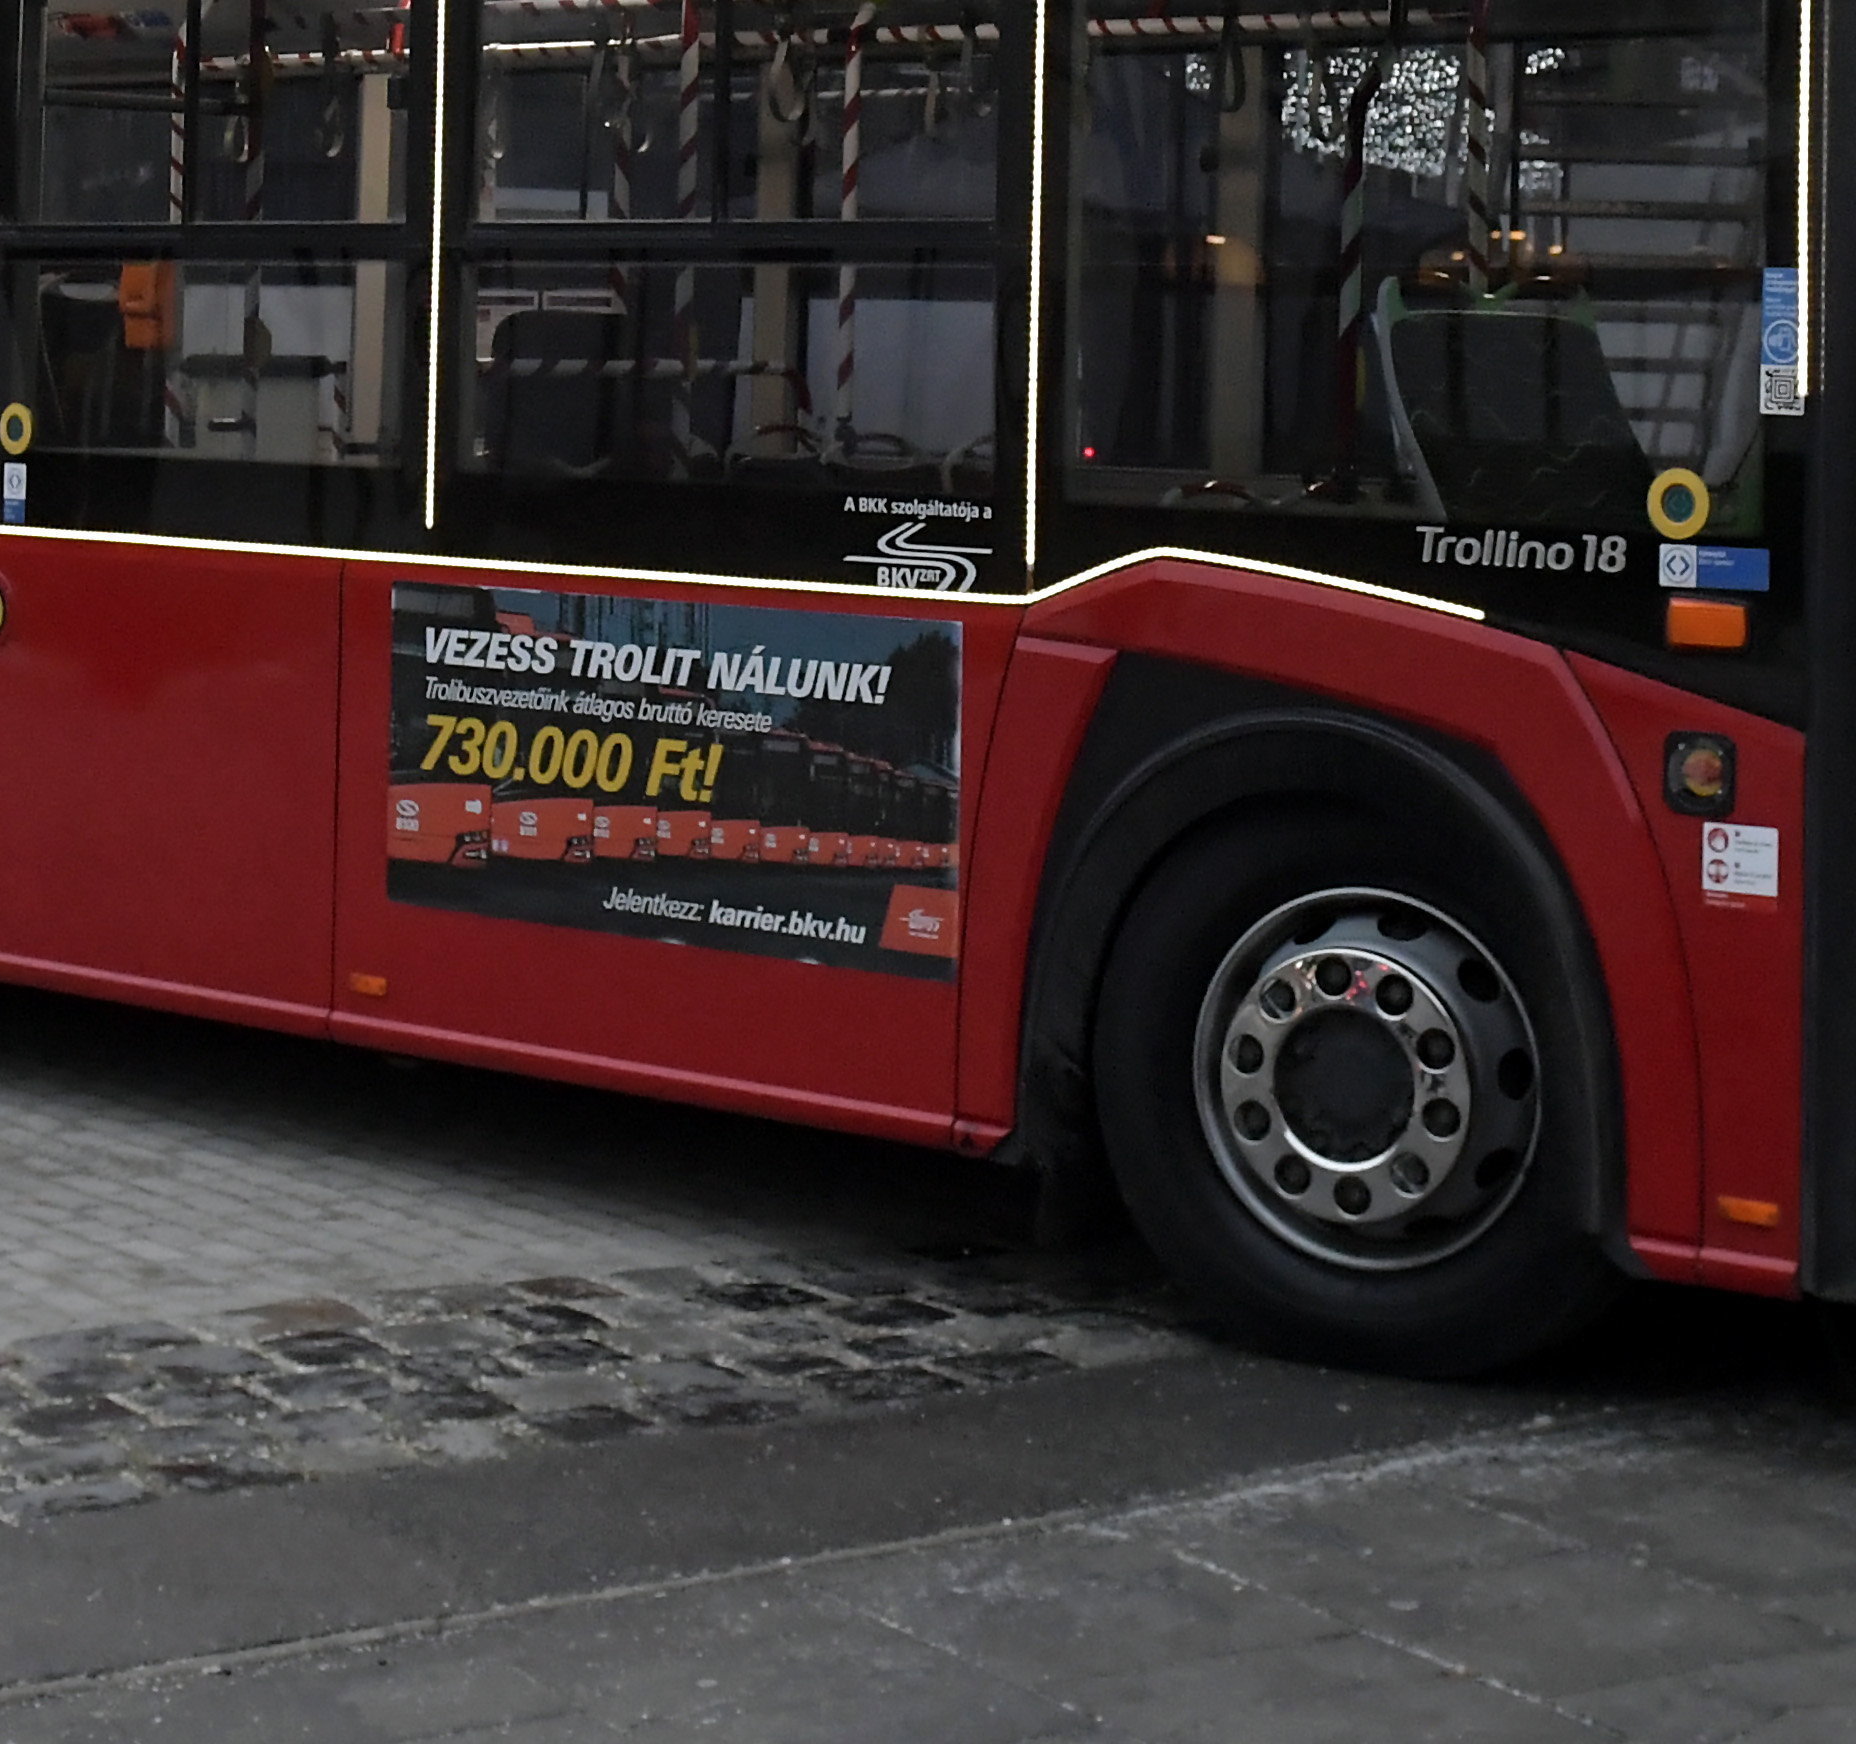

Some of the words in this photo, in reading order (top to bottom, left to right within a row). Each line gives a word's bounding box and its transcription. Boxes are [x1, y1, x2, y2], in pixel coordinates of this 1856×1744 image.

[843, 496, 856, 512] A
[858, 497, 888, 514] BKK
[890, 498, 979, 523] szolgáltatója
[982, 506, 992, 519] a
[1415, 525, 1575, 572] Trollino
[1582, 534, 1628, 574] 18
[424, 626, 558, 675] VEZESS
[568, 639, 701, 688] TROLIT
[707, 644, 893, 705] NÁLUNK!
[424, 676, 569, 714] Trolibuszvezetőink
[572, 689, 634, 724] átlagos
[637, 697, 693, 726] bruttó
[695, 707, 774, 735] keresete
[420, 713, 633, 793] 730.000
[645, 737, 724, 803] Ft!
[603, 886, 705, 922] Jelentkezz:
[708, 900, 867, 945] karrier.bkv.hu
